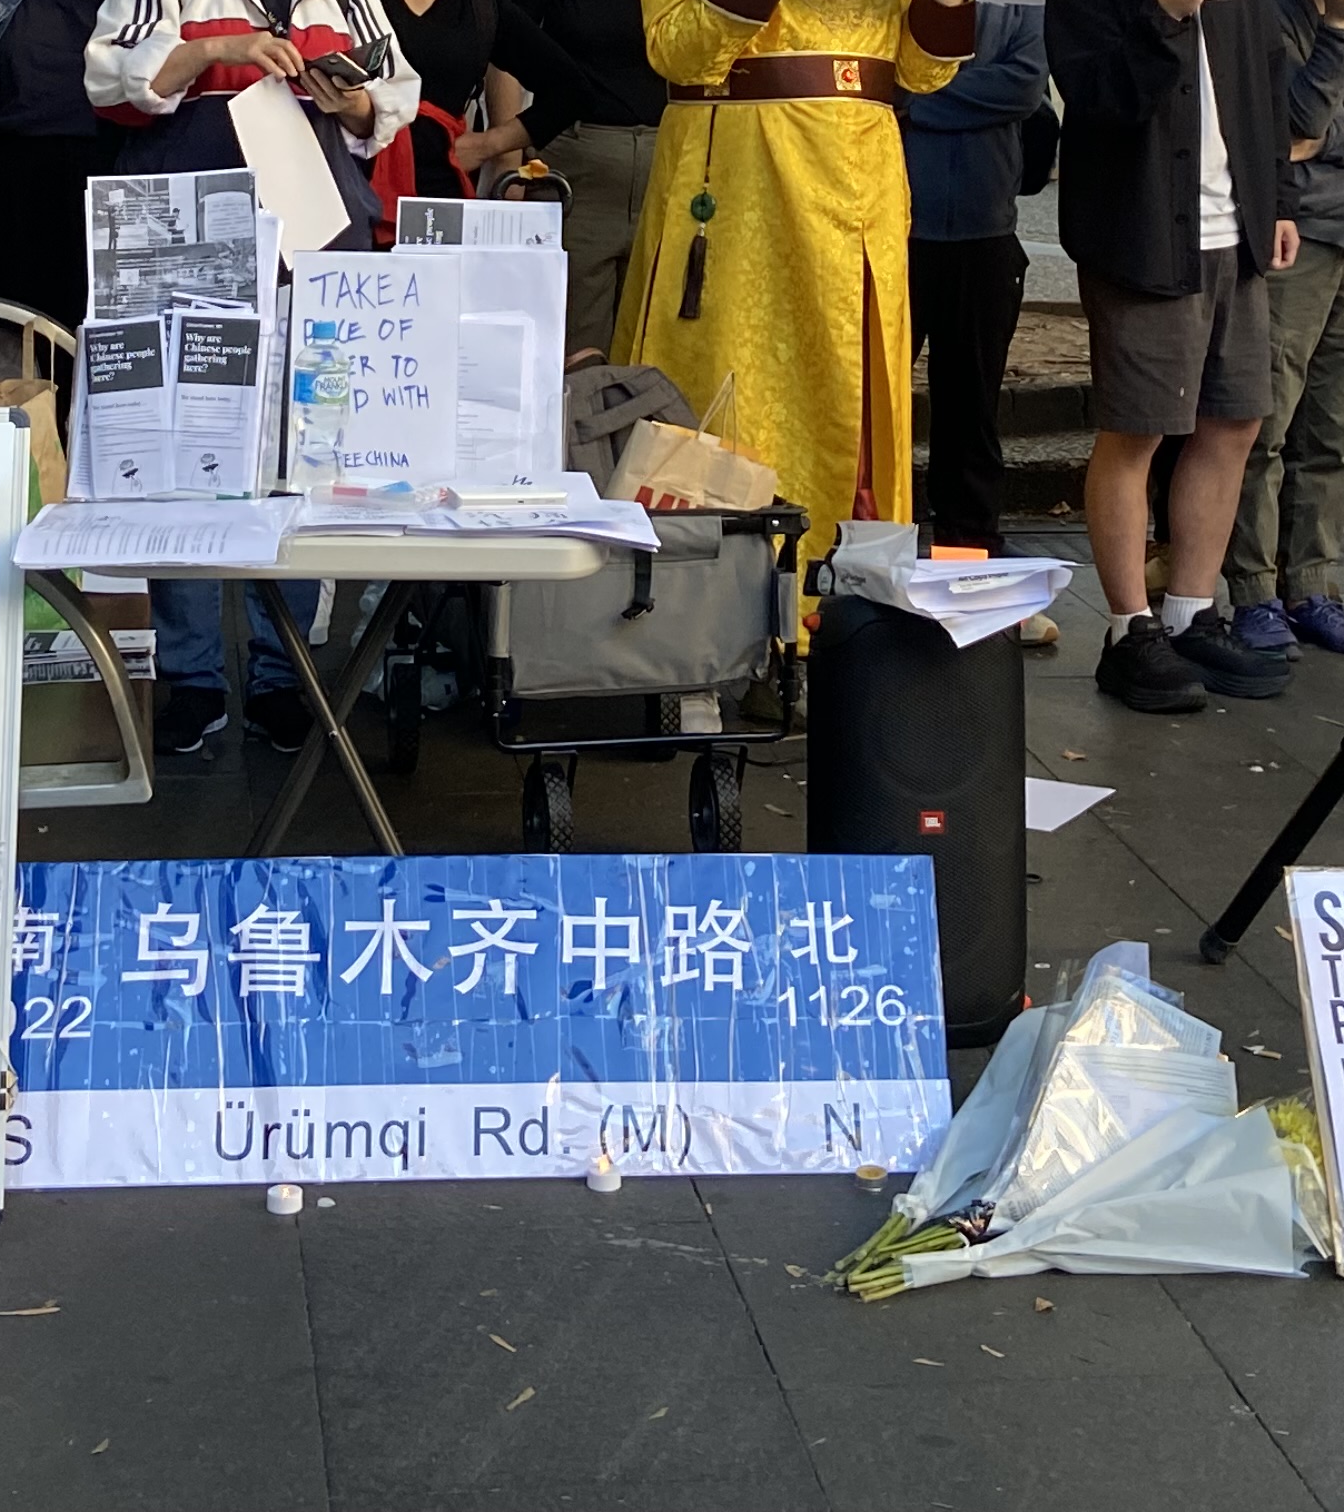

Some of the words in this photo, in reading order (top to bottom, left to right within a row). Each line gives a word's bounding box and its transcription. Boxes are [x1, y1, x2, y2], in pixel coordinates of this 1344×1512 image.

[309, 271, 394, 309] TAKE
[403, 273, 420, 307] A
[185, 332, 205, 343] Why
[206, 335, 222, 343] are
[378, 318, 414, 341] OF
[89, 343, 108, 353] Why
[110, 341, 125, 350] are
[90, 352, 125, 363] Chinese
[126, 348, 156, 359] people
[184, 343, 221, 353] Chinese
[222, 344, 252, 355] people
[90, 361, 132, 372] gathering
[183, 354, 227, 366] gathering
[183, 363, 209, 373] here?
[391, 355, 418, 378] TO
[382, 385, 429, 409] WITH
[121, 897, 753, 998] 乌鲁木齐中路
[791, 897, 860, 968] 北
[778, 985, 908, 1030] 1126
[5, 1114, 33, 1167] S
[214, 1101, 429, 1166] Ürümqi
[472, 1104, 572, 1159] Rd.
[599, 1100, 694, 1166] (M)
[824, 1102, 864, 1154] N
